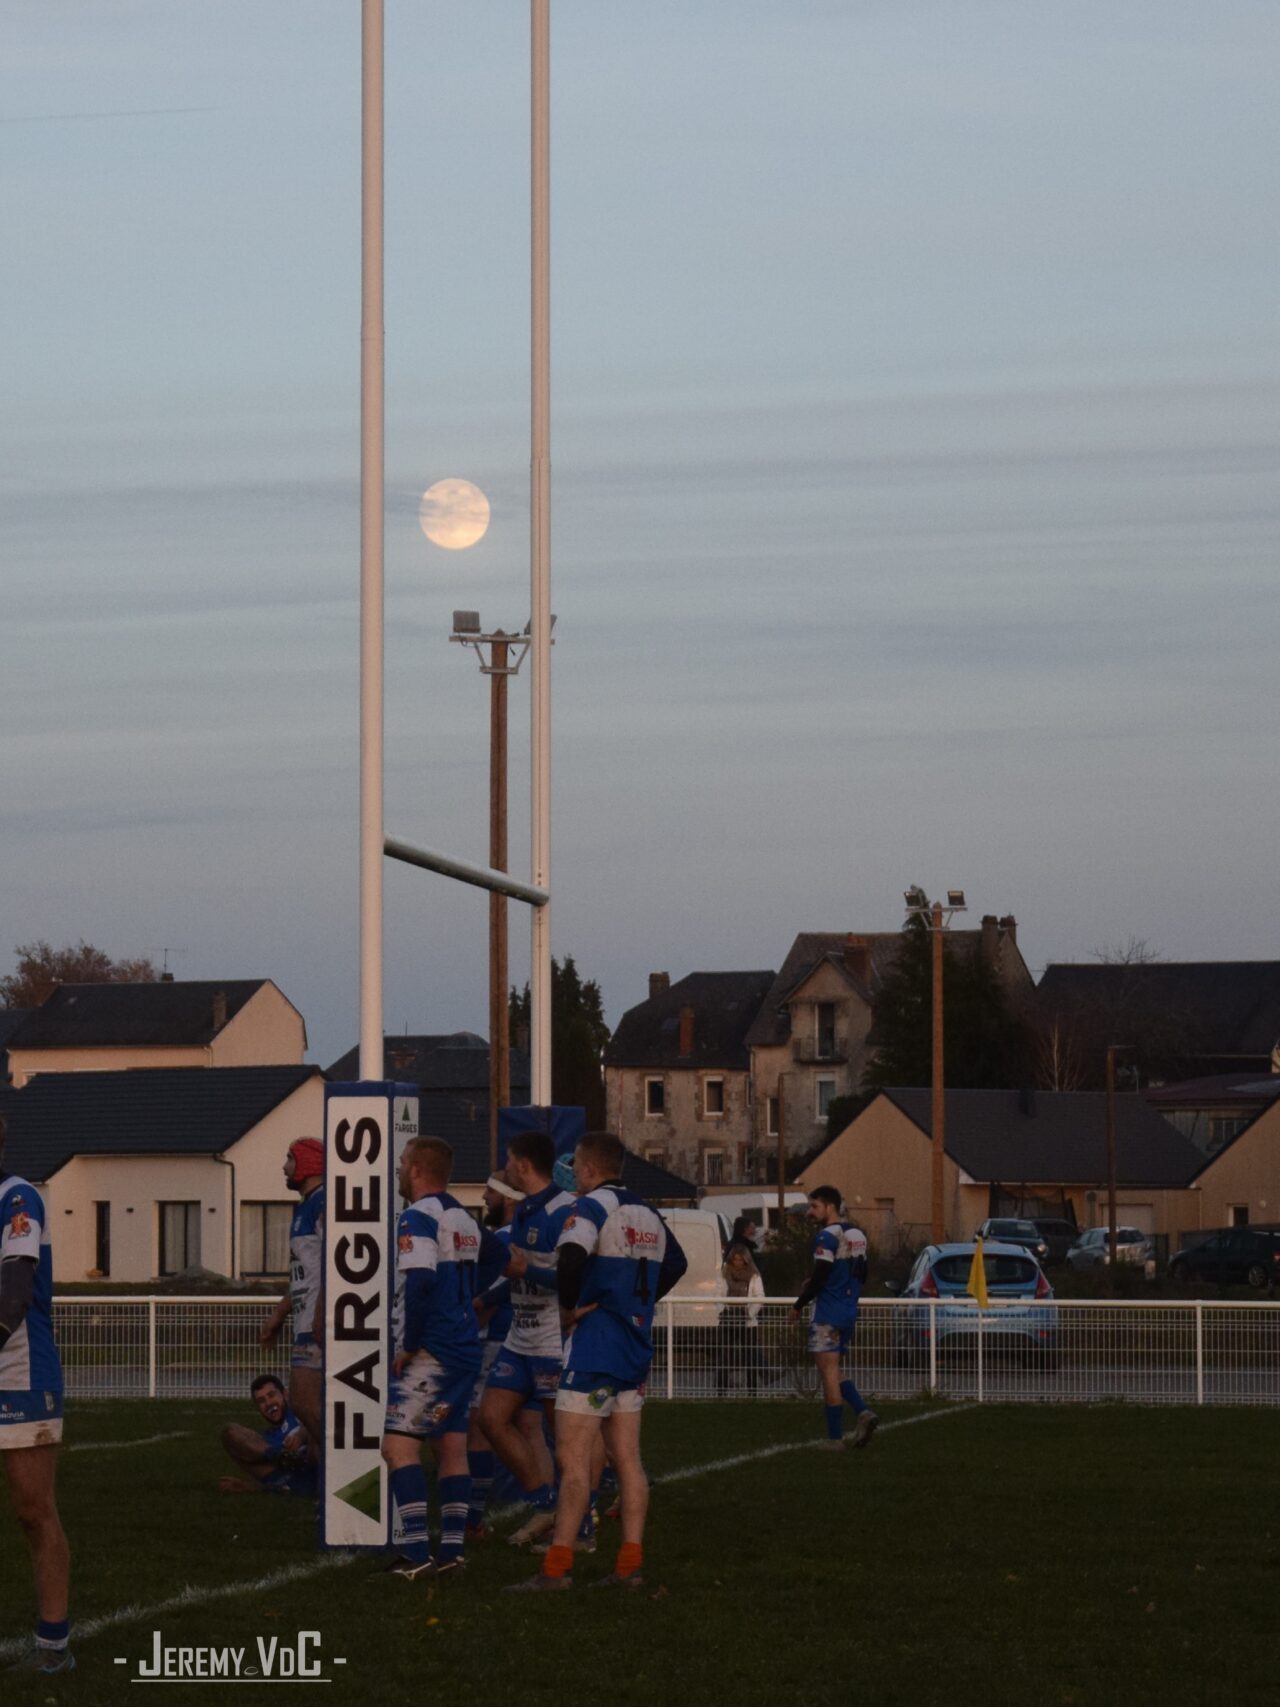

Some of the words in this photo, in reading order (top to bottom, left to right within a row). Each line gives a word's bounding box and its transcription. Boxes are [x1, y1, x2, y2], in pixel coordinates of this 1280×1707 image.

[395, 1123, 417, 1133] FARGES
[333, 1116, 381, 1449] FARGES
[632, 1257, 651, 1306] 4
